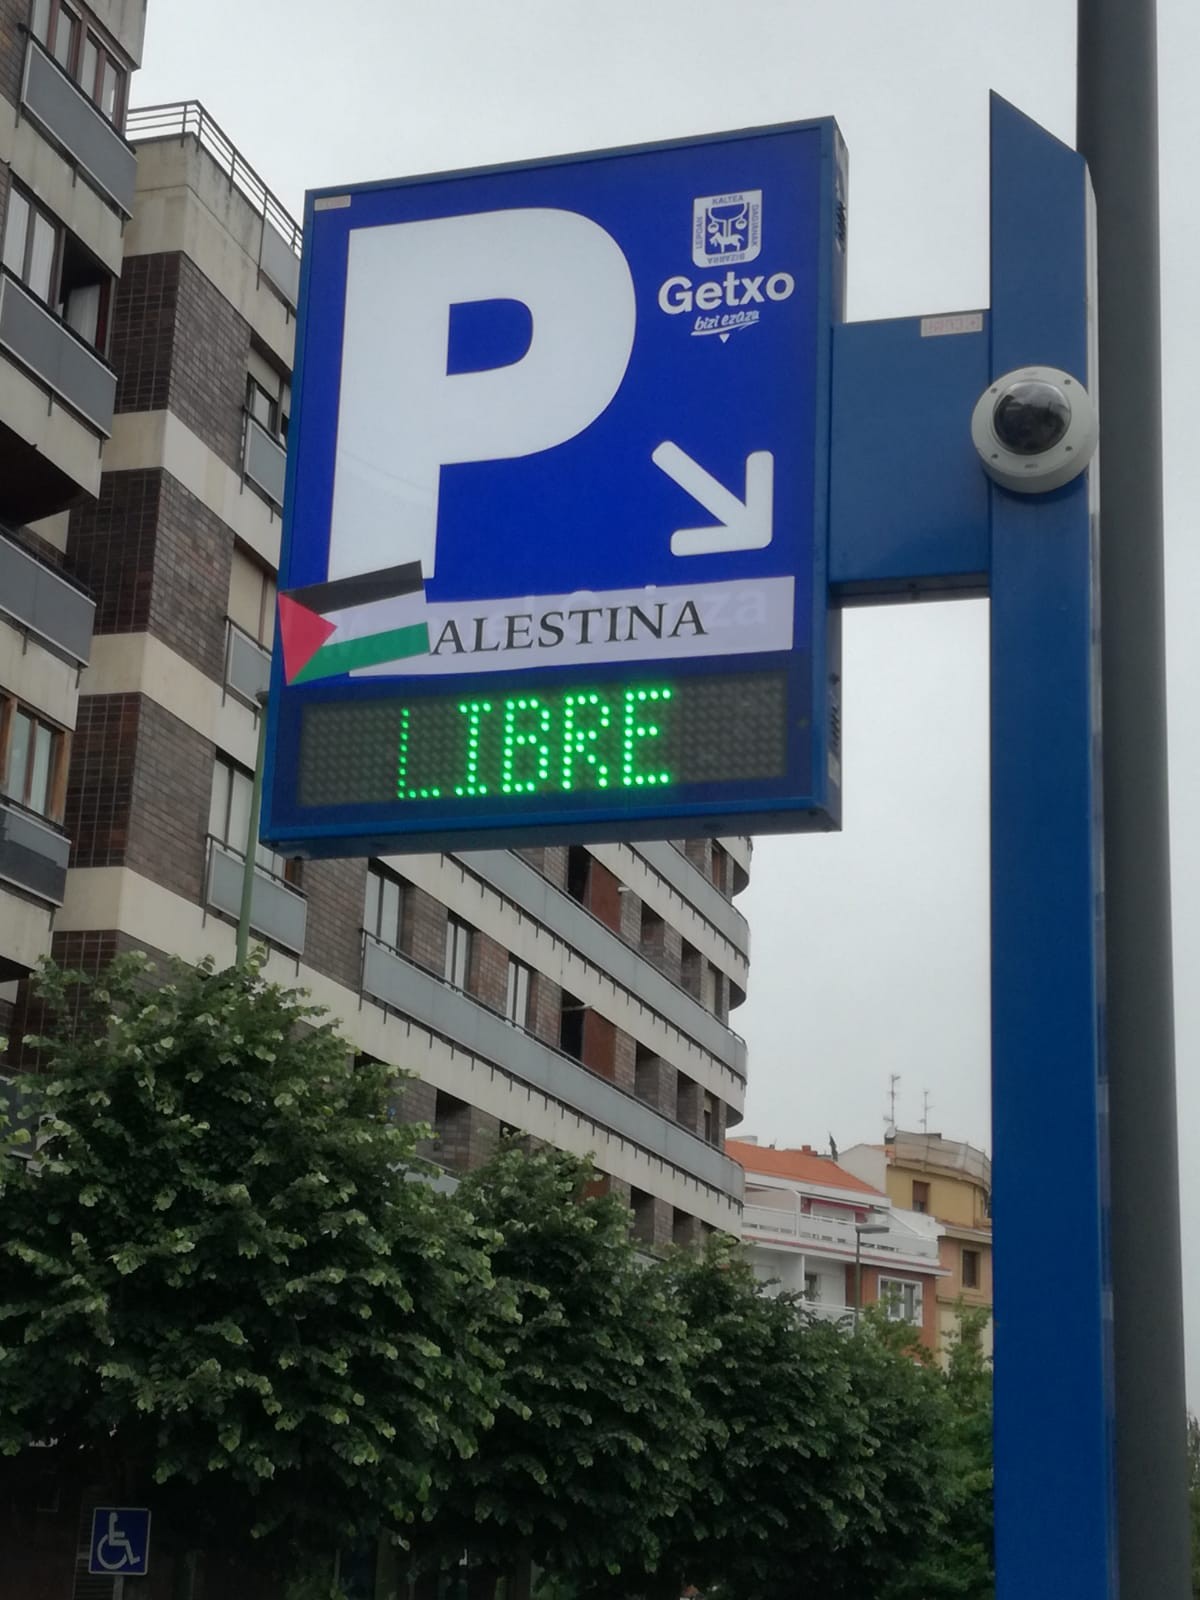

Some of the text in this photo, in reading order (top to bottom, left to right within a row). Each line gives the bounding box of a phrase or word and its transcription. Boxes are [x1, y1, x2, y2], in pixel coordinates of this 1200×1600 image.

[712, 195, 744, 205] KALTEA
[658, 271, 795, 315] Getxo
[694, 315, 718, 331] bizi
[328, 207, 636, 582] P
[428, 599, 709, 656] ALESTINA
[396, 688, 673, 800] LIBRE
